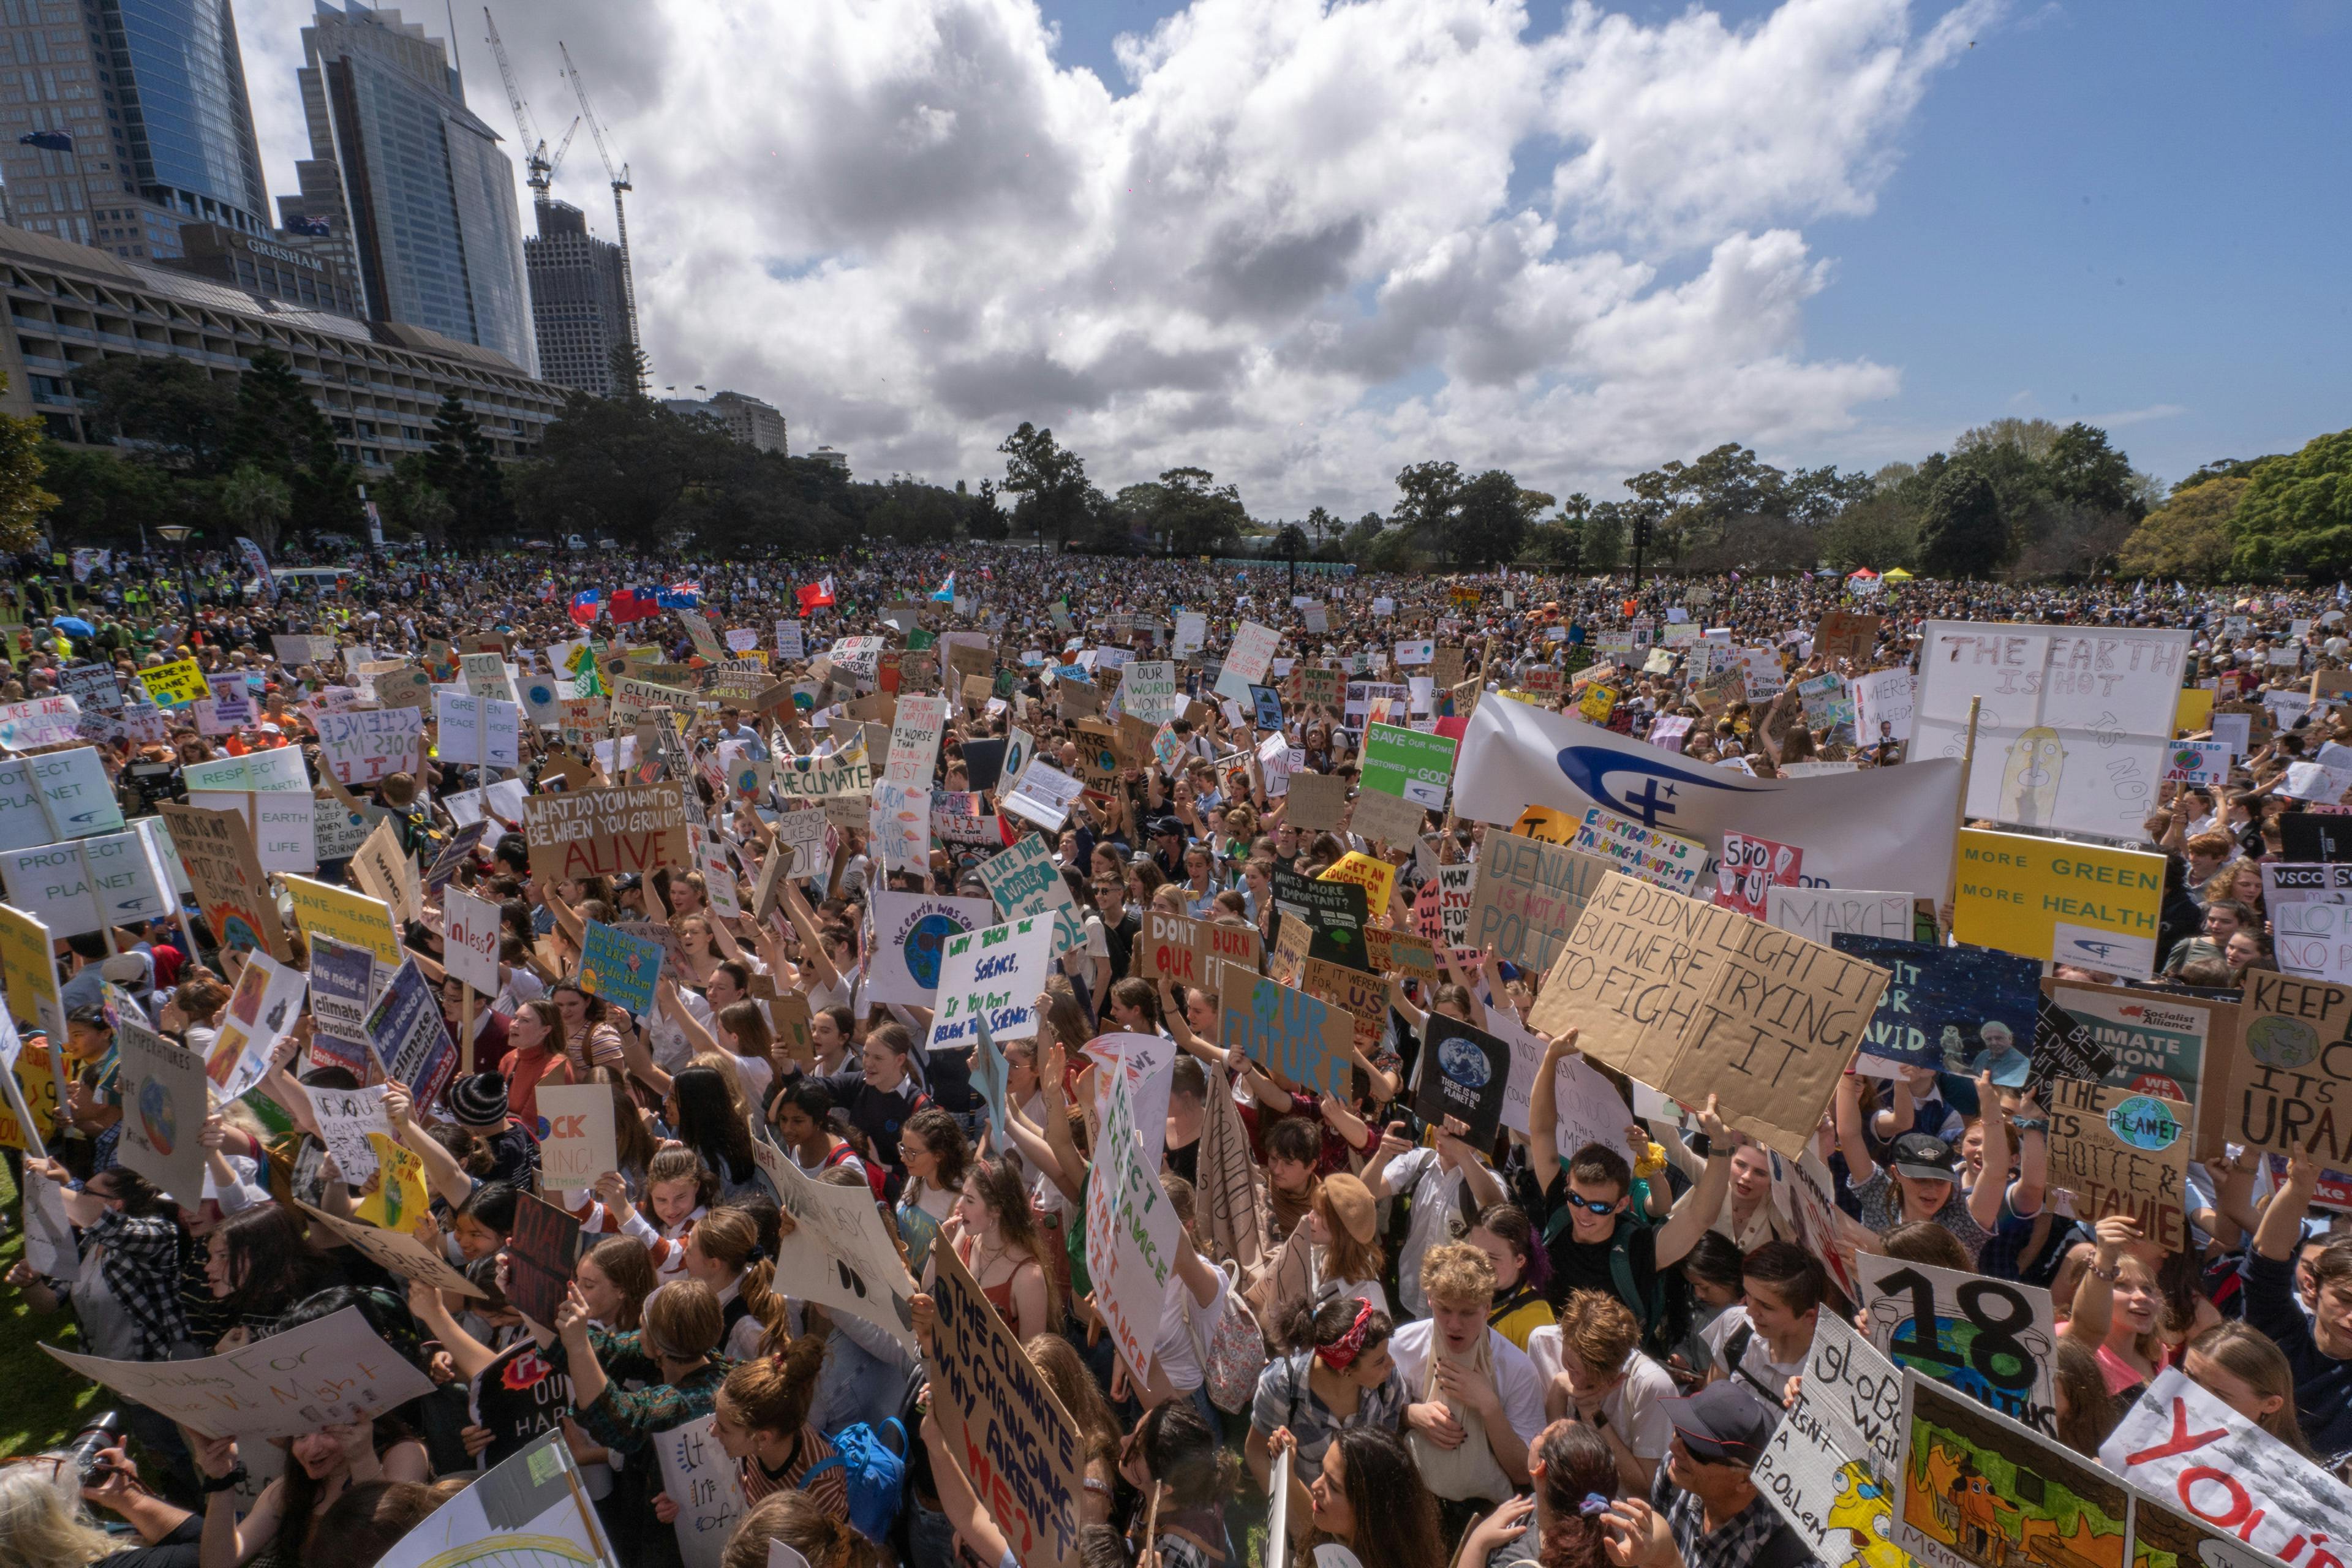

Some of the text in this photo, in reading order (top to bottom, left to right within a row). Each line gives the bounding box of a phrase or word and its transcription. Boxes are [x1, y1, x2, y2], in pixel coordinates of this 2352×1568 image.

[1692, 639, 1709, 649] HELL
[1941, 635, 2182, 676] THE EARTH
[469, 656, 496, 673] ECO
[1138, 666, 1163, 680] OUR
[1305, 669, 1336, 680] DENIAL
[1525, 672, 1561, 681] LOVE
[175, 689, 184, 699] B
[625, 683, 690, 706] CLIMATE
[710, 688, 737, 697] AREA
[1129, 682, 1174, 695] WORLD
[1994, 668, 2124, 697] IS HOT
[39, 697, 67, 714] THE
[451, 699, 502, 714] GREEN
[571, 707, 588, 717] NO
[902, 699, 933, 712] FAILING
[1139, 710, 1162, 722] LAST
[444, 717, 514, 733] PEACE HOPE
[560, 716, 606, 729] PLANET
[905, 728, 934, 742] WORSE
[897, 739, 915, 748] THAN
[1371, 728, 1453, 755] SAVE OUR HOME
[2206, 742, 2222, 751] NO
[925, 753, 932, 762] A
[1221, 752, 1251, 776] STOP
[203, 760, 278, 785] RESPECT
[776, 765, 870, 796] THE CLIMATE
[891, 762, 921, 780] TEST
[1365, 756, 1449, 785] BESTOWED GOD
[2212, 772, 2220, 782] B
[262, 813, 308, 823] EARTH
[522, 787, 678, 826] WHAT DO YOU WANT TO
[315, 821, 342, 832] WHEN
[527, 812, 664, 847] BE WHEN YOU GROW
[783, 812, 820, 827] SCOMO
[942, 815, 985, 831] HEAT
[269, 842, 300, 853] LIFE
[317, 828, 368, 843] THE EARTH
[19, 842, 126, 871] PROTECT
[564, 831, 677, 878] ALIVE.
[981, 834, 1046, 884] LIKE THE
[1632, 849, 1673, 877] ABOUT
[1725, 840, 1790, 867] STOP
[1371, 865, 1385, 882] AN
[1441, 869, 1469, 888] WHY
[1490, 839, 1591, 909] DENIAL
[1965, 848, 2158, 891] MORE GREEN
[2274, 871, 2324, 884] VSCO
[45, 872, 136, 900] PLANET
[1004, 867, 1044, 900] WATER
[1275, 872, 1345, 897] WHAT'S MORE
[1281, 886, 1349, 910] IMPORTANT?
[1497, 885, 1567, 927] IS NOT A
[1722, 895, 1734, 905] TO
[1962, 883, 2156, 930] MORE HEALTH
[290, 892, 391, 931] SAVE EARTH
[894, 901, 960, 946] the earth was
[1779, 897, 1907, 944] MARCH
[2281, 906, 2335, 933] NO
[588, 940, 601, 954] old
[949, 925, 1009, 957] WHY TEACH
[1153, 914, 1251, 958] DON'T BURN
[1365, 926, 1432, 948] STOP DENYING
[1591, 875, 1885, 1004] WE DIDN'T LIGHT IT
[1156, 944, 1195, 981] OUR
[1372, 956, 1392, 970] IS
[2281, 939, 2328, 968] NO
[314, 964, 366, 993] We need a
[606, 967, 622, 981] die
[1311, 976, 1332, 990] FOR
[1313, 962, 1346, 979] IF IT
[1571, 912, 1858, 1051] BUT WE'RE TRYING
[1893, 959, 1922, 986] IT
[315, 997, 362, 1021] climate
[1349, 987, 1383, 1015] US
[2254, 975, 2345, 1021] KEEP
[1557, 949, 1807, 1088] TO FIGHT IT
[2143, 1009, 2195, 1024] Socialist
[2143, 1016, 2193, 1031] Alliance
[123, 1023, 190, 1071] TEMPERATURES
[393, 1010, 432, 1081] climate
[1515, 1038, 1539, 1066] NOT
[2067, 1025, 2108, 1061] BET
[1129, 1050, 1156, 1070] WE
[1441, 1076, 1480, 1103] THERE IS NO
[2145, 1077, 2171, 1089] WE
[2249, 1063, 2337, 1103] IT'S
[316, 1096, 331, 1118] IF
[1443, 1087, 1469, 1106] PLANET
[2056, 1077, 2184, 1142] THE PLANET
[1572, 1120, 1596, 1139] THIS
[2051, 1112, 2081, 1139] IS
[2049, 1137, 2178, 1202] HOTTER
[1873, 1266, 2038, 1390] 18
[956, 1316, 971, 1366] IS
[228, 1346, 318, 1380] For
[951, 1273, 1075, 1474] THE CLIMATE
[269, 1360, 380, 1405] Might
[932, 1323, 1071, 1562] WHY AREN'T
[1774, 1430, 1789, 1452] A
[963, 1419, 1033, 1568] WE?
